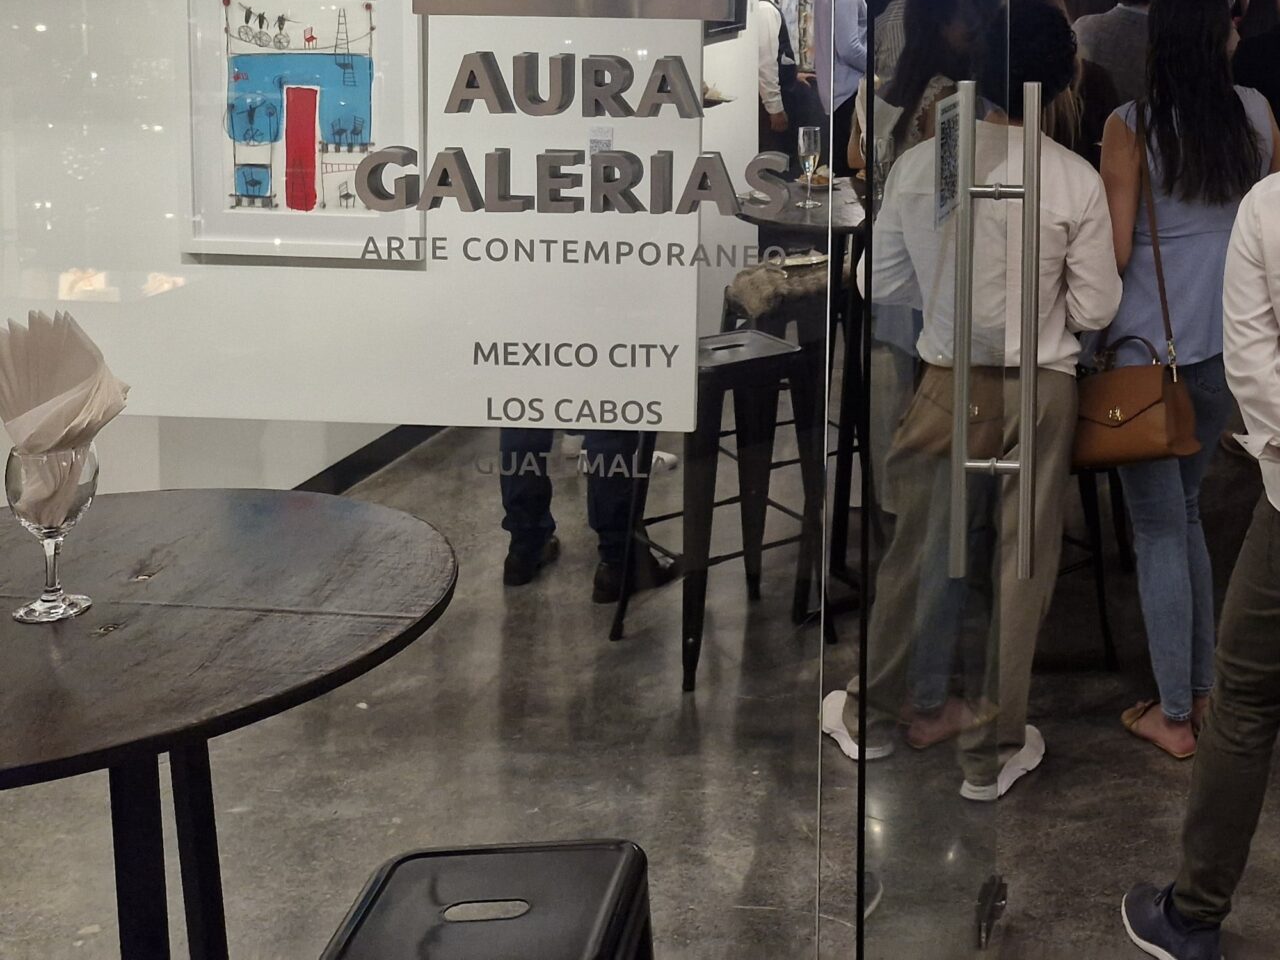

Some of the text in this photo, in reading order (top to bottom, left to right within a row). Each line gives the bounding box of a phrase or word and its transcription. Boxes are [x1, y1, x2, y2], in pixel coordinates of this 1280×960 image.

[444, 51, 705, 119] AURA
[354, 146, 791, 216] GALERIAS
[360, 235, 786, 269] ARTE CONTEMPORANEO
[472, 341, 680, 369] MEXICO CITY
[486, 397, 664, 426] LOS CABOS
